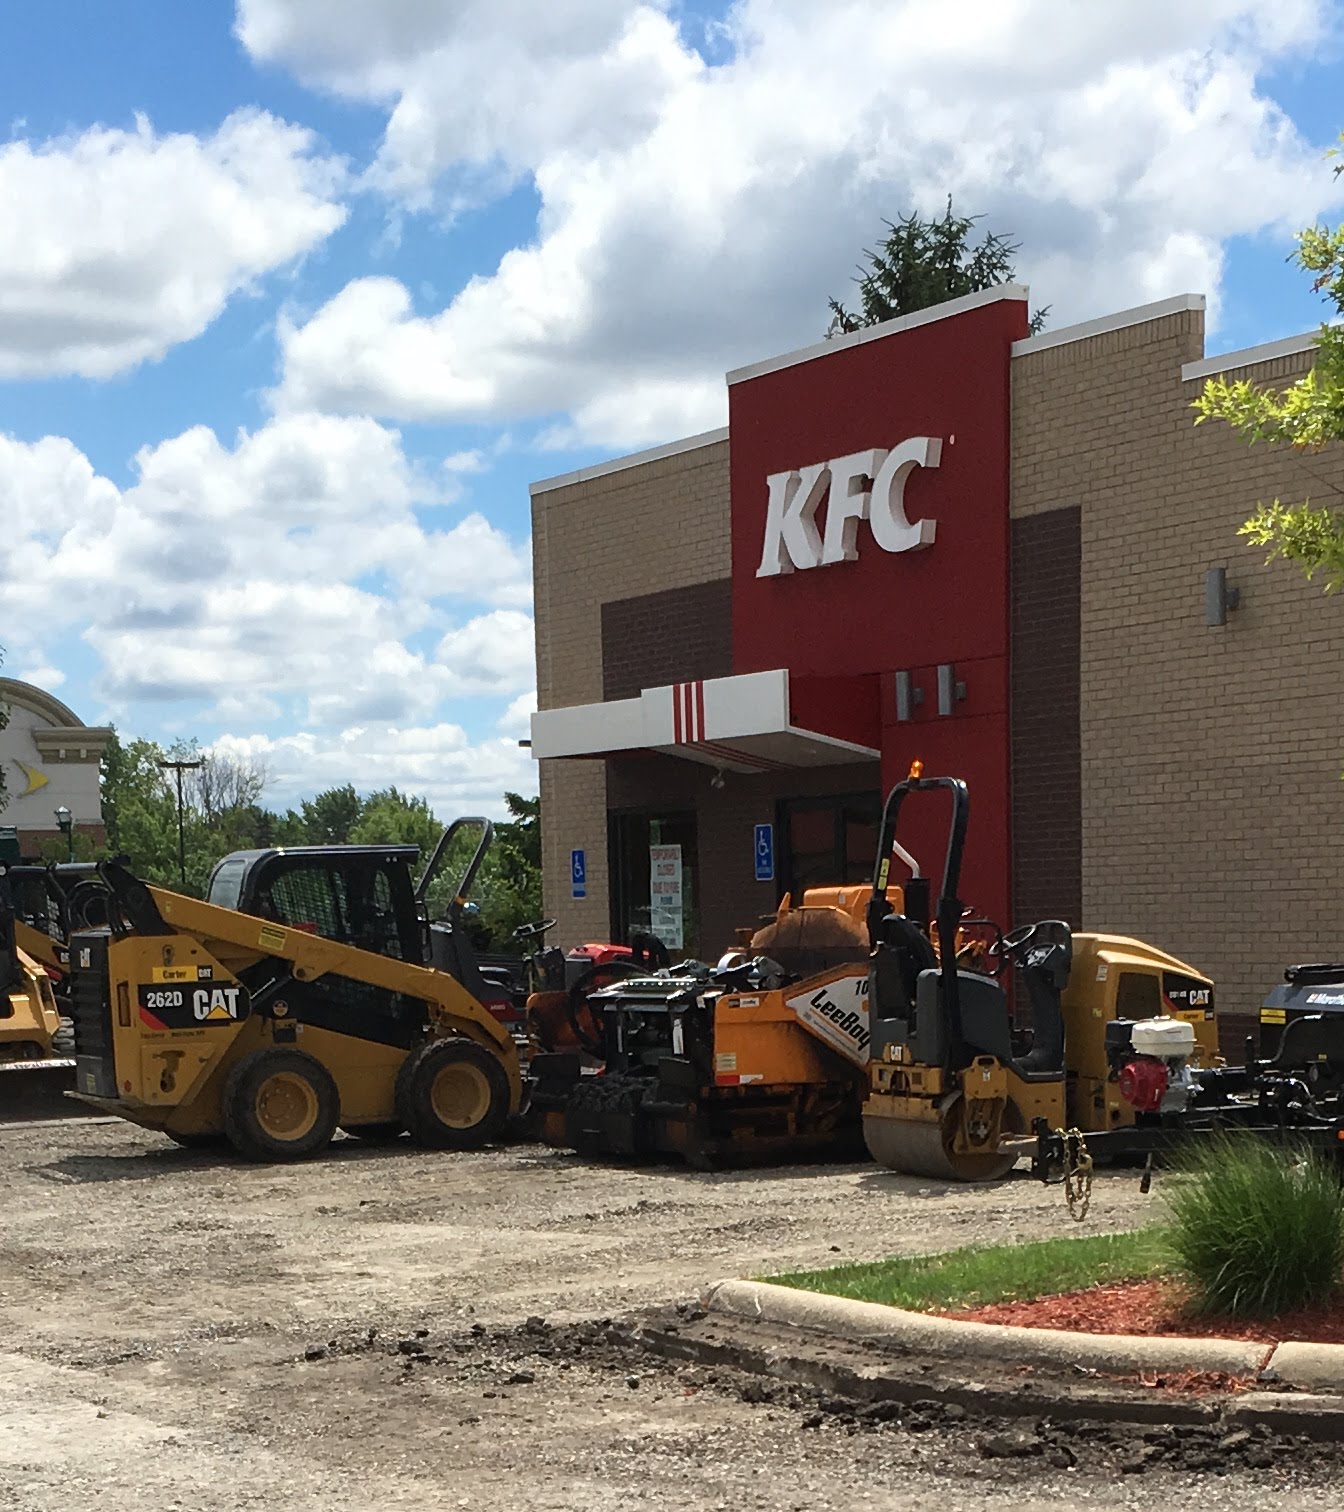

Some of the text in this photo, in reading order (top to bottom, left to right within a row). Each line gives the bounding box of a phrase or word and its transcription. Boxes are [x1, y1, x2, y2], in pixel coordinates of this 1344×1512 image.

[756, 436, 943, 578] KFC
[198, 968, 212, 978] CAT
[146, 988, 240, 1020] 262D CAT
[1189, 990, 1211, 1006] CAT
[810, 989, 872, 1051] LeeBoy
